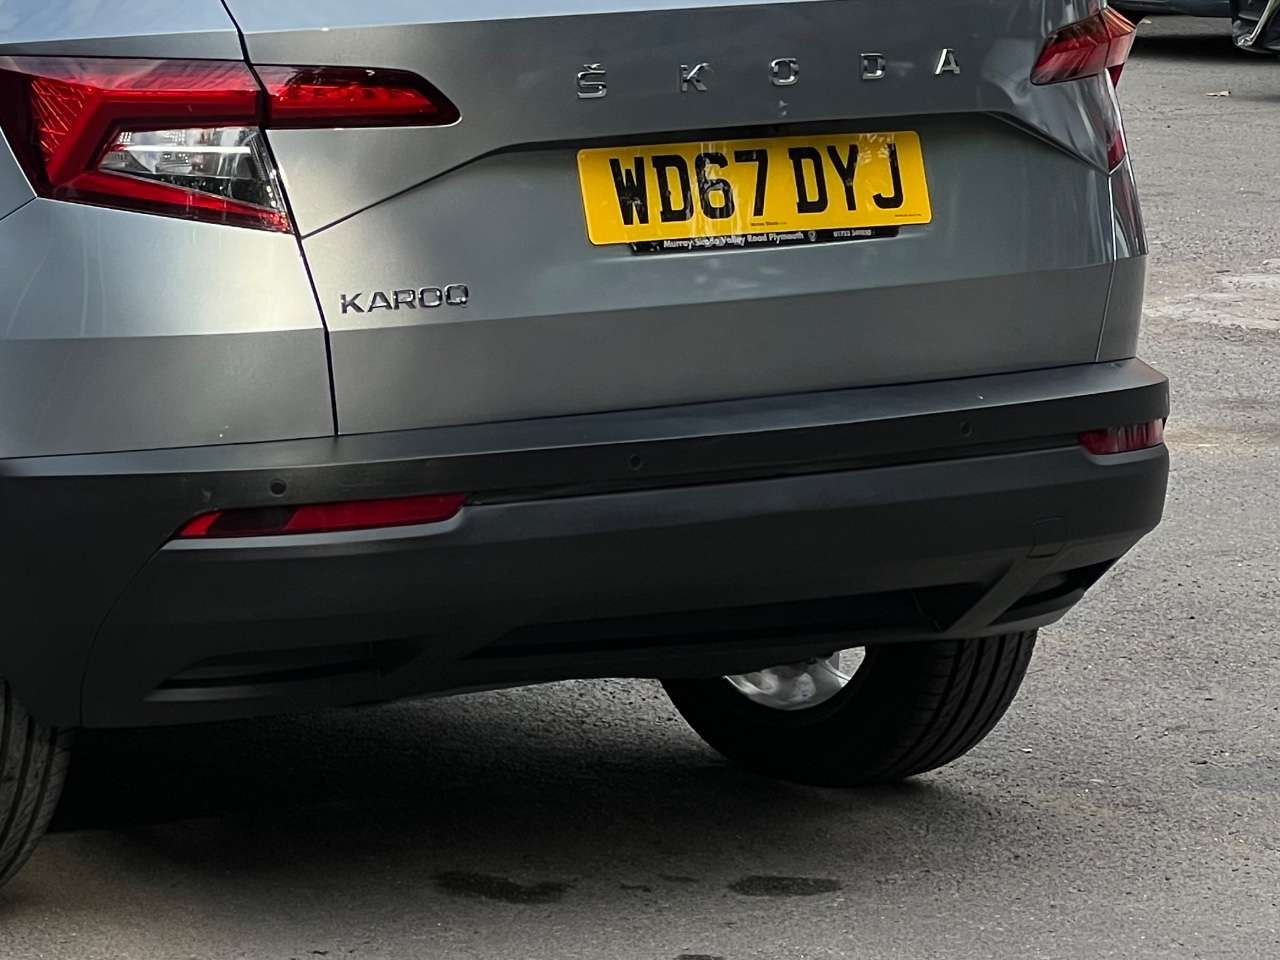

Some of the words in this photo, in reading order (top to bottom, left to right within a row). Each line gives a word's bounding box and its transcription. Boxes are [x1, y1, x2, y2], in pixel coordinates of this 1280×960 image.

[609, 149, 768, 226] WD67
[788, 143, 904, 215] DYJ
[664, 239, 693, 250] Murray
[721, 234, 745, 246] Valley
[747, 234, 767, 243] Road
[769, 231, 804, 244] Plymouth
[340, 283, 469, 314] KAROQ
